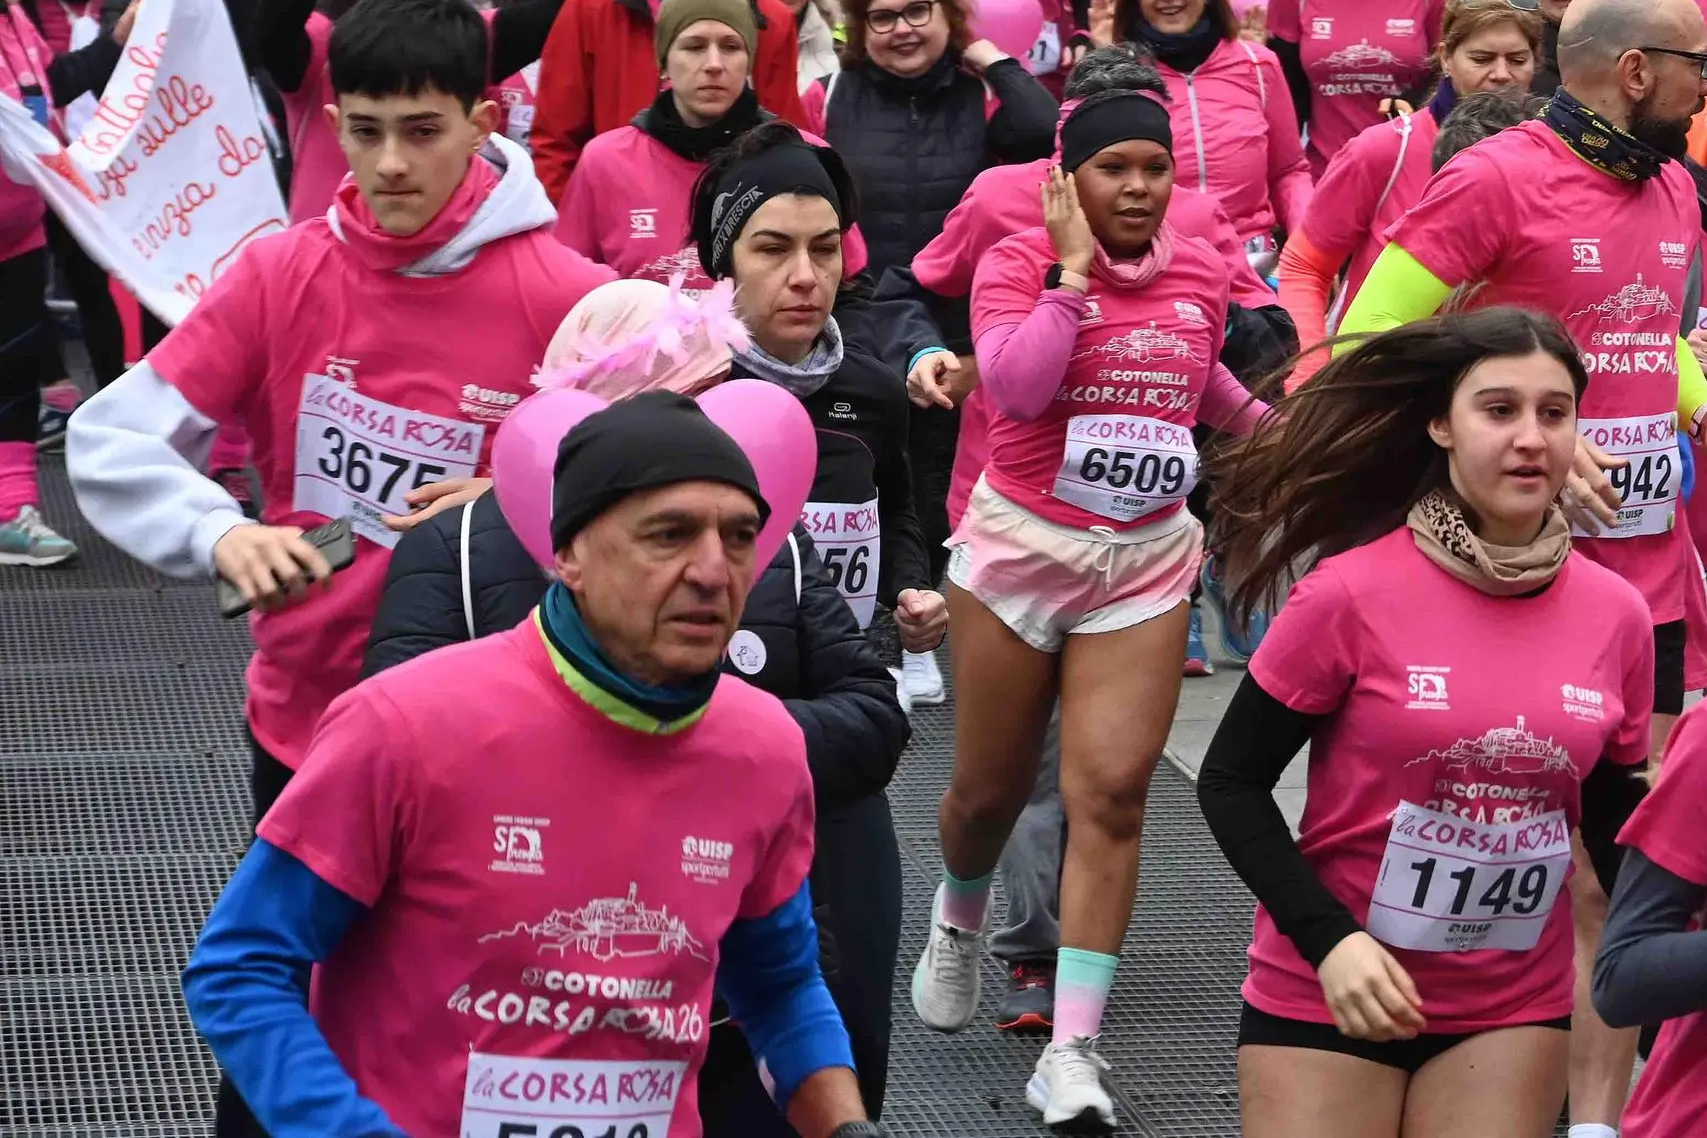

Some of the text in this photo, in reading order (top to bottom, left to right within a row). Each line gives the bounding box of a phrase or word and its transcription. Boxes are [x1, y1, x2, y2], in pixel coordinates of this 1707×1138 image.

[1602, 333, 1671, 346] COTONELLA
[1583, 351, 1632, 374] ORSA
[1110, 369, 1189, 386] COTONELLA
[325, 392, 395, 438] CORSA
[1086, 421, 1150, 442] CORSA
[1079, 447, 1186, 495] 6509
[1610, 454, 1672, 503] 942
[1122, 497, 1146, 508] UISP
[1625, 509, 1644, 519] UISP
[800, 511, 837, 533] RSA
[824, 545, 870, 593] 56
[699, 839, 733, 860] UISP
[1416, 817, 1508, 856] CORSA
[1410, 858, 1548, 915] 1149
[545, 970, 674, 998] COTONELLA
[475, 990, 597, 1036] CORSA
[500, 1071, 608, 1104] CORSA
